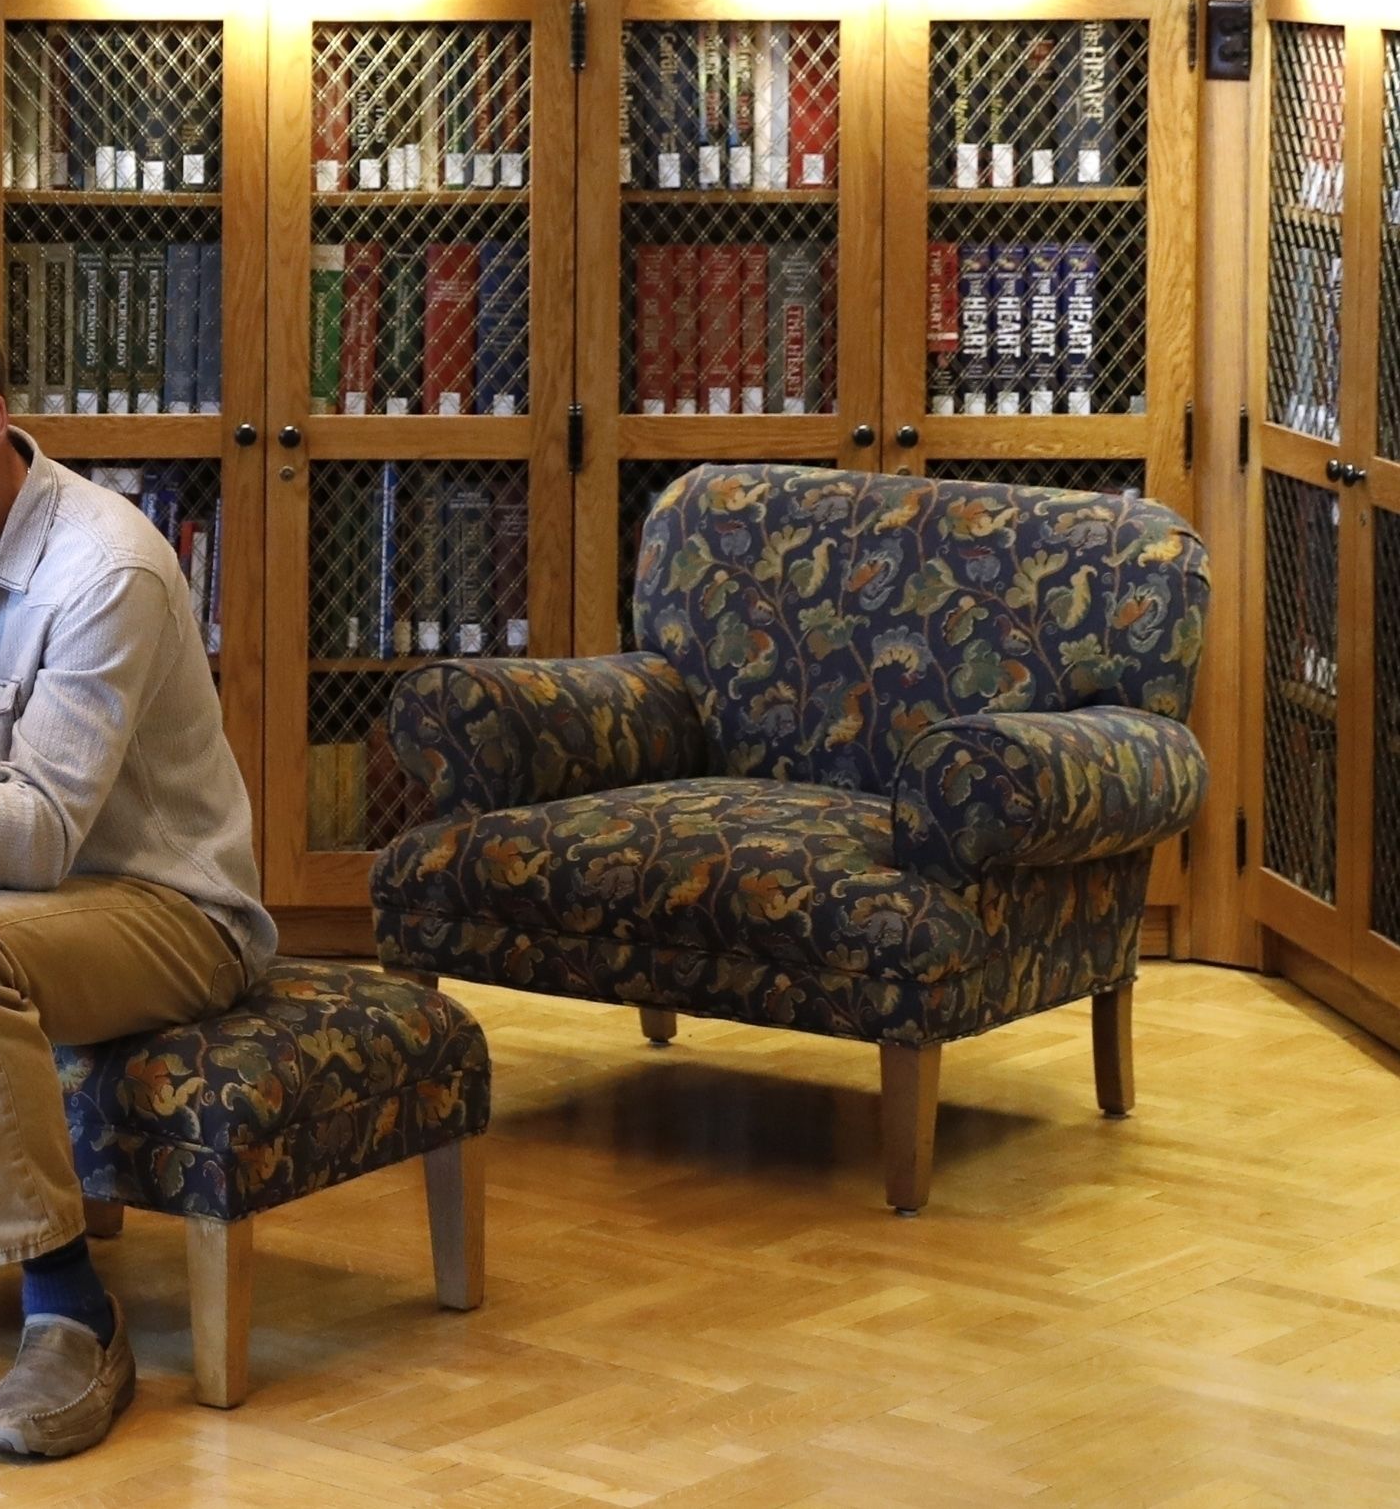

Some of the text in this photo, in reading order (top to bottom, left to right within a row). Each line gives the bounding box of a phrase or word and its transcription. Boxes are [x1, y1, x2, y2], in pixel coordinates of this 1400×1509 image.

[1082, 47, 1105, 124] HEART
[930, 283, 942, 331] HEART
[963, 297, 988, 358] HEART
[997, 297, 1022, 358] HEART
[1032, 296, 1057, 357] HEART
[1068, 296, 1093, 358] HEART
